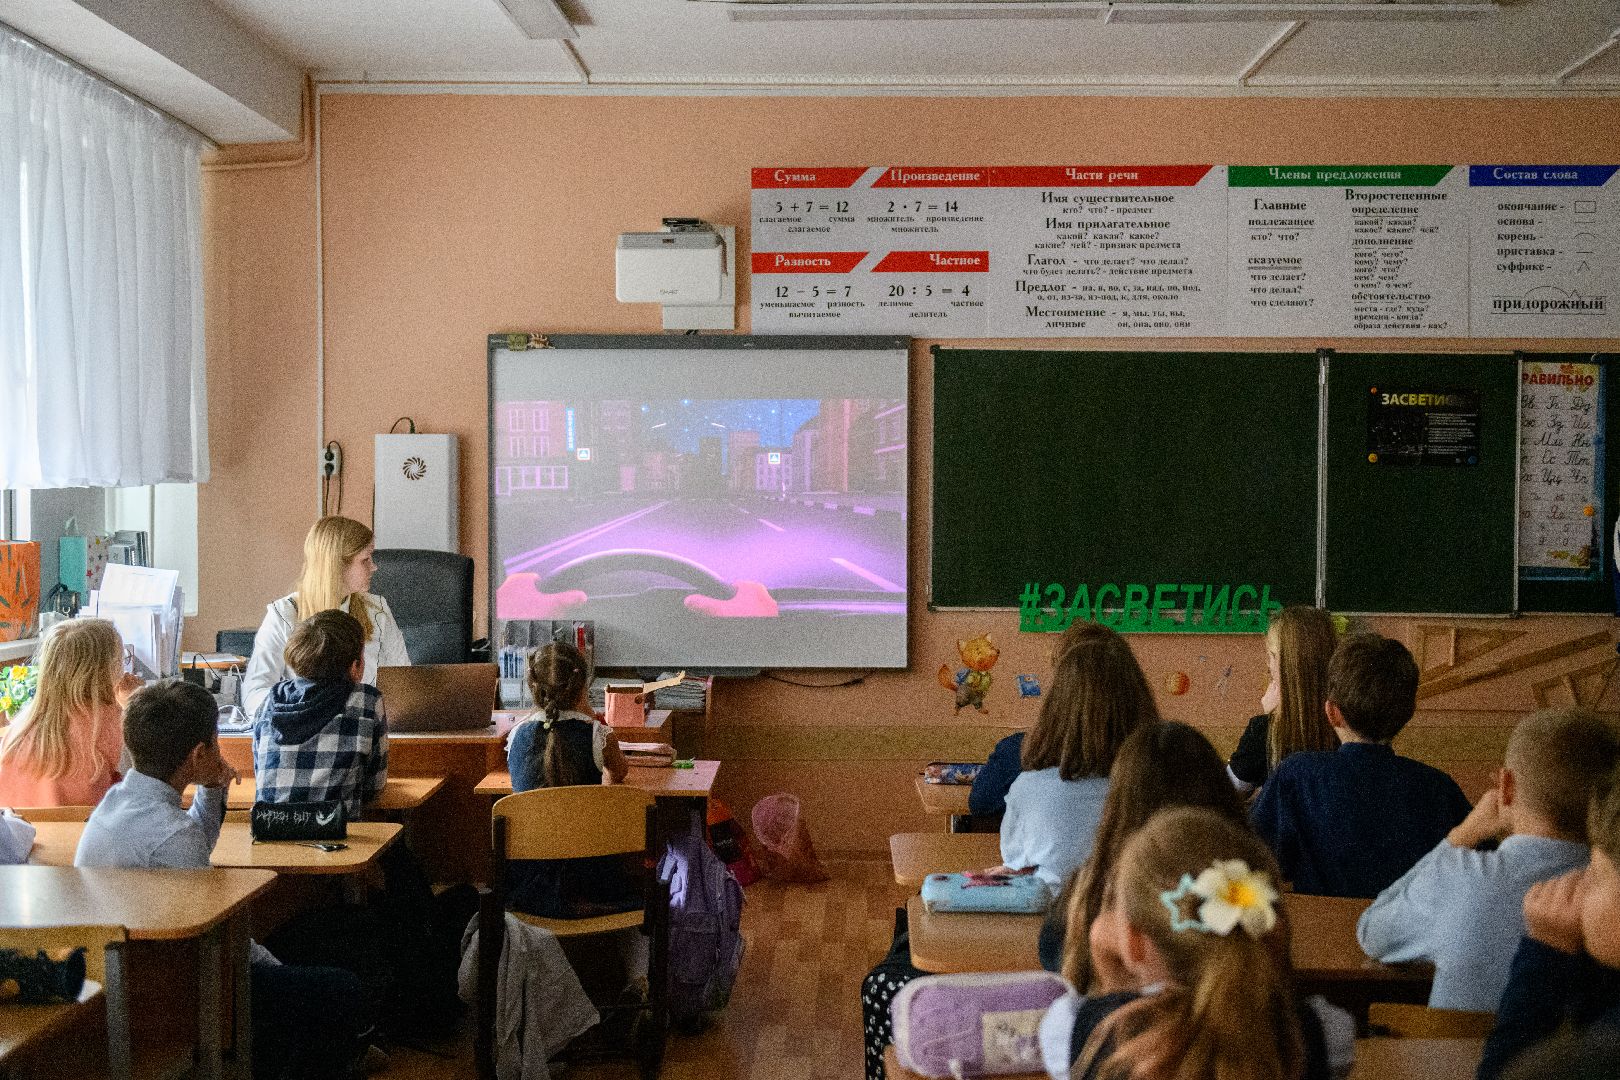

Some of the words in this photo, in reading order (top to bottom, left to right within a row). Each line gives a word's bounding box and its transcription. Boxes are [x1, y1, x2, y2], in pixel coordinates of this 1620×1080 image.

[774, 170, 816, 182] Сумма
[891, 170, 980, 182] Произведение
[1066, 168, 1103, 180] Части
[1108, 171, 1138, 182] речи
[1269, 168, 1311, 180] Члены
[1317, 171, 1401, 181] предложения
[1493, 168, 1537, 179] Состав
[1042, 192, 1067, 203] Имя
[1073, 194, 1174, 205] существительное
[1345, 189, 1447, 201] Второстепенные
[776, 202, 782, 213] 5
[791, 203, 799, 211] +
[806, 202, 813, 213] 7
[836, 201, 849, 213] 12
[888, 201, 894, 212] 2
[915, 201, 922, 212] 7
[945, 201, 958, 212] 14
[1254, 199, 1306, 210] Главные
[1352, 206, 1418, 214] определение
[1046, 218, 1072, 229] Имя
[1078, 221, 1170, 229] прилагательное
[1248, 219, 1314, 227] подлежащее
[1057, 232, 1088, 240] какой?
[1498, 233, 1536, 242] корень
[1352, 238, 1413, 246] дополнение
[1497, 249, 1555, 257] приставка
[775, 256, 831, 266] Разность
[930, 254, 980, 265] Частное
[1028, 254, 1066, 265] Глагол
[1248, 257, 1302, 266] сказуемое
[1497, 262, 1544, 273] суффикс
[776, 286, 788, 297] 12
[813, 286, 819, 297] 5
[845, 285, 851, 297] 7
[889, 285, 904, 296] 20
[925, 285, 932, 296] 5
[962, 285, 970, 296] 4
[1015, 281, 1066, 293] Предлог
[761, 301, 816, 309] уменьшаемое
[1493, 295, 1603, 312] придорожный
[1026, 307, 1105, 317] Местоимение
[1019, 583, 1283, 626] #ЗАСВЕТИСЬ
